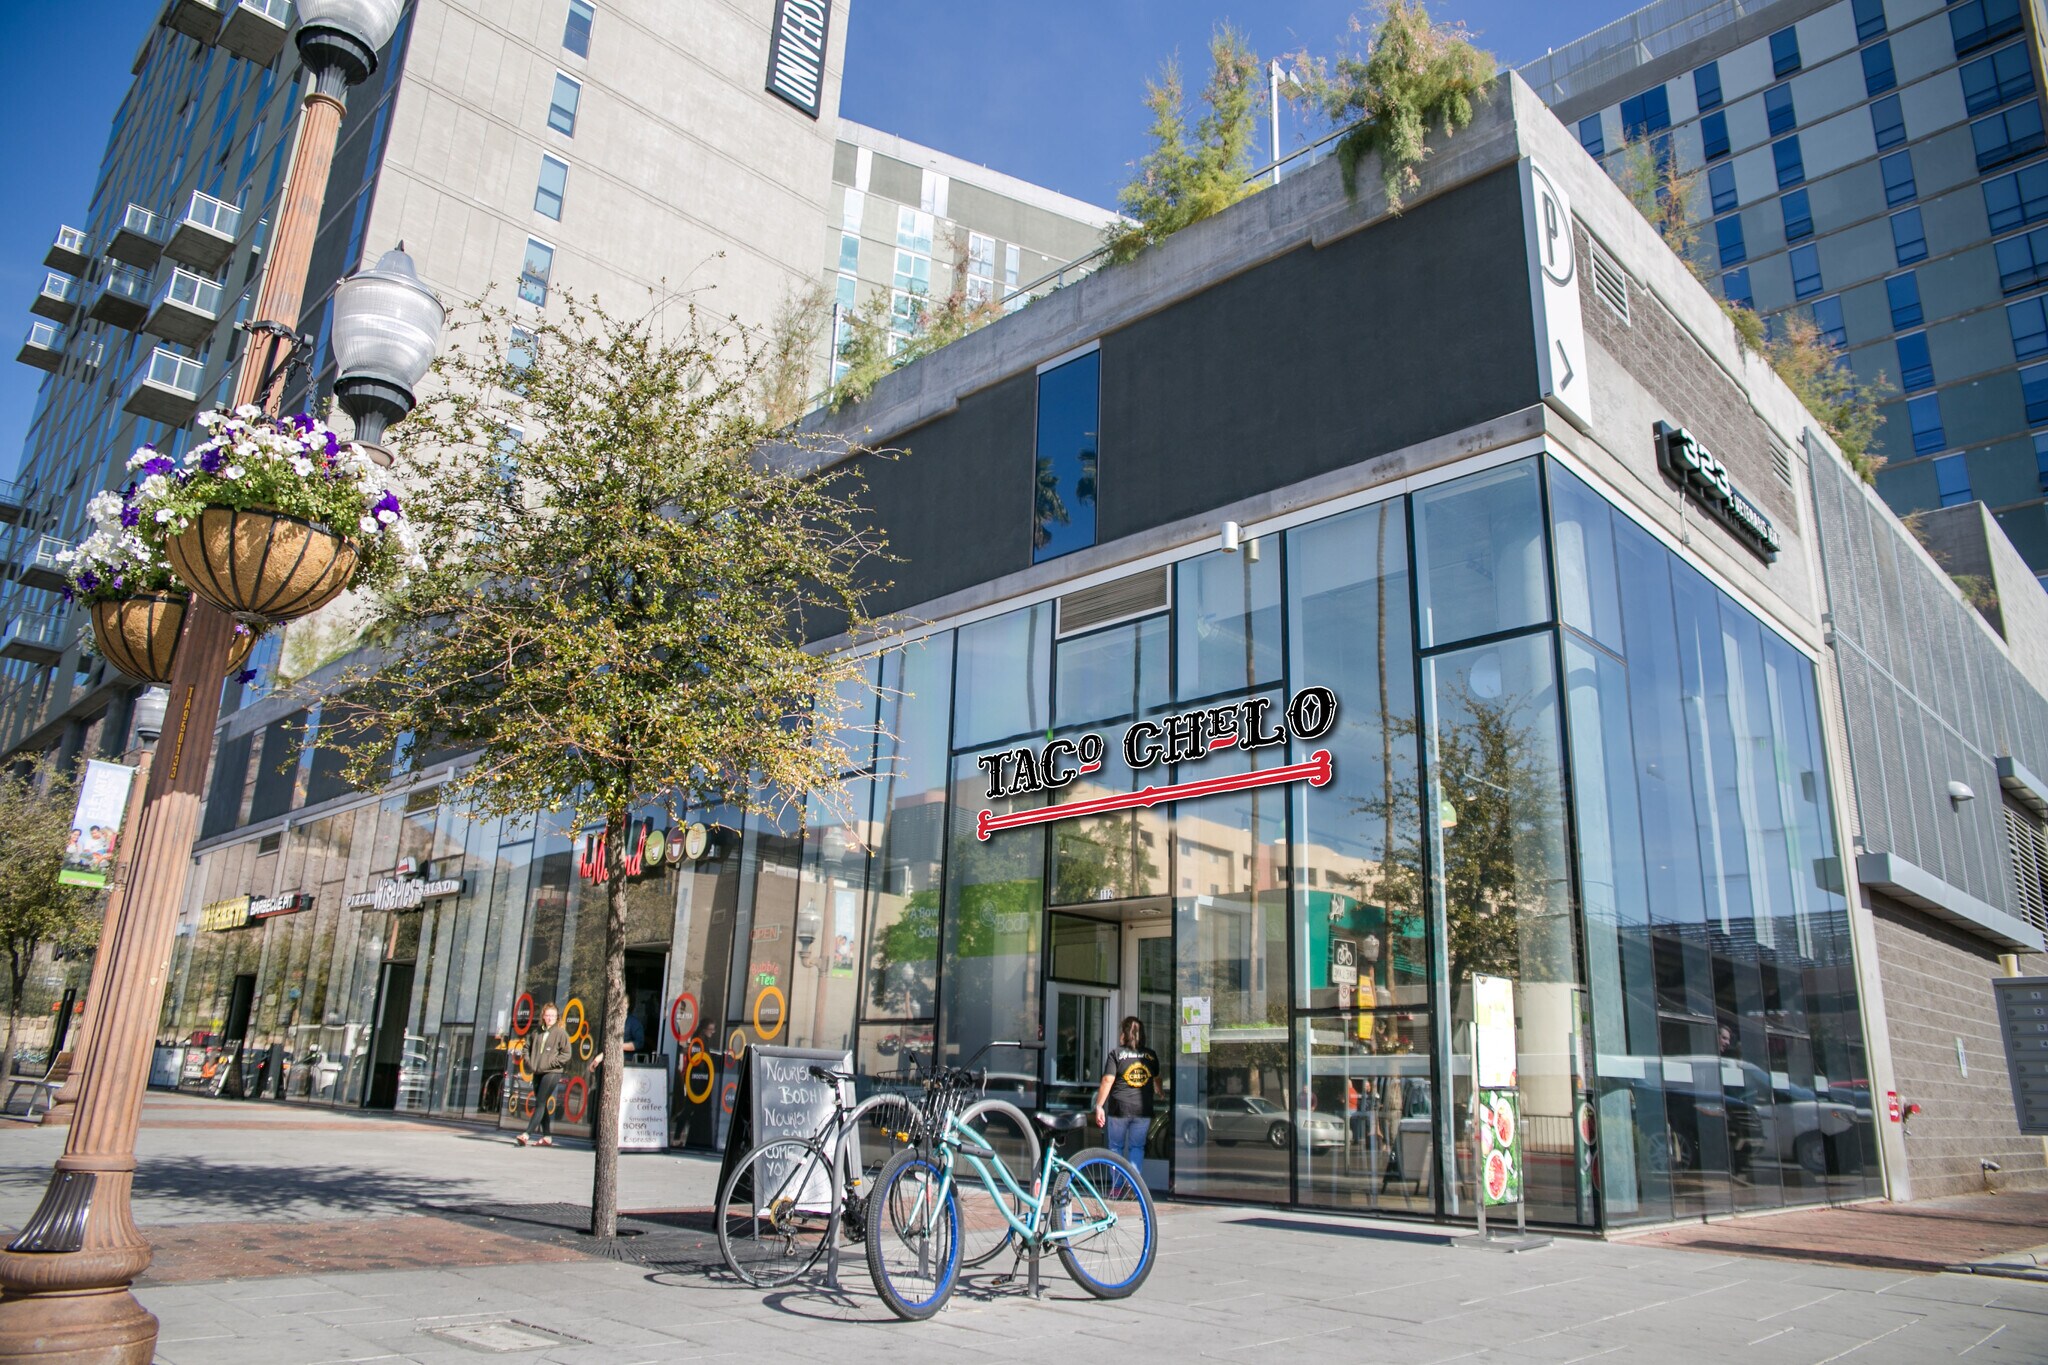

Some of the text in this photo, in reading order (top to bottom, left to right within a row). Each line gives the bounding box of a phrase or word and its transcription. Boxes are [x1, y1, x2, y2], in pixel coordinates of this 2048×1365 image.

[1680, 427, 1731, 499] 323
[417, 879, 452, 897] SALAD
[250, 897, 283, 916] BARBECUE
[346, 892, 372, 907] PIZZA
[751, 927, 777, 939] OPEN
[759, 973, 776, 986] Tea
[623, 1096, 652, 1104] Sushies
[778, 1085, 823, 1105] BODHI
[637, 1103, 662, 1111] Coffee
